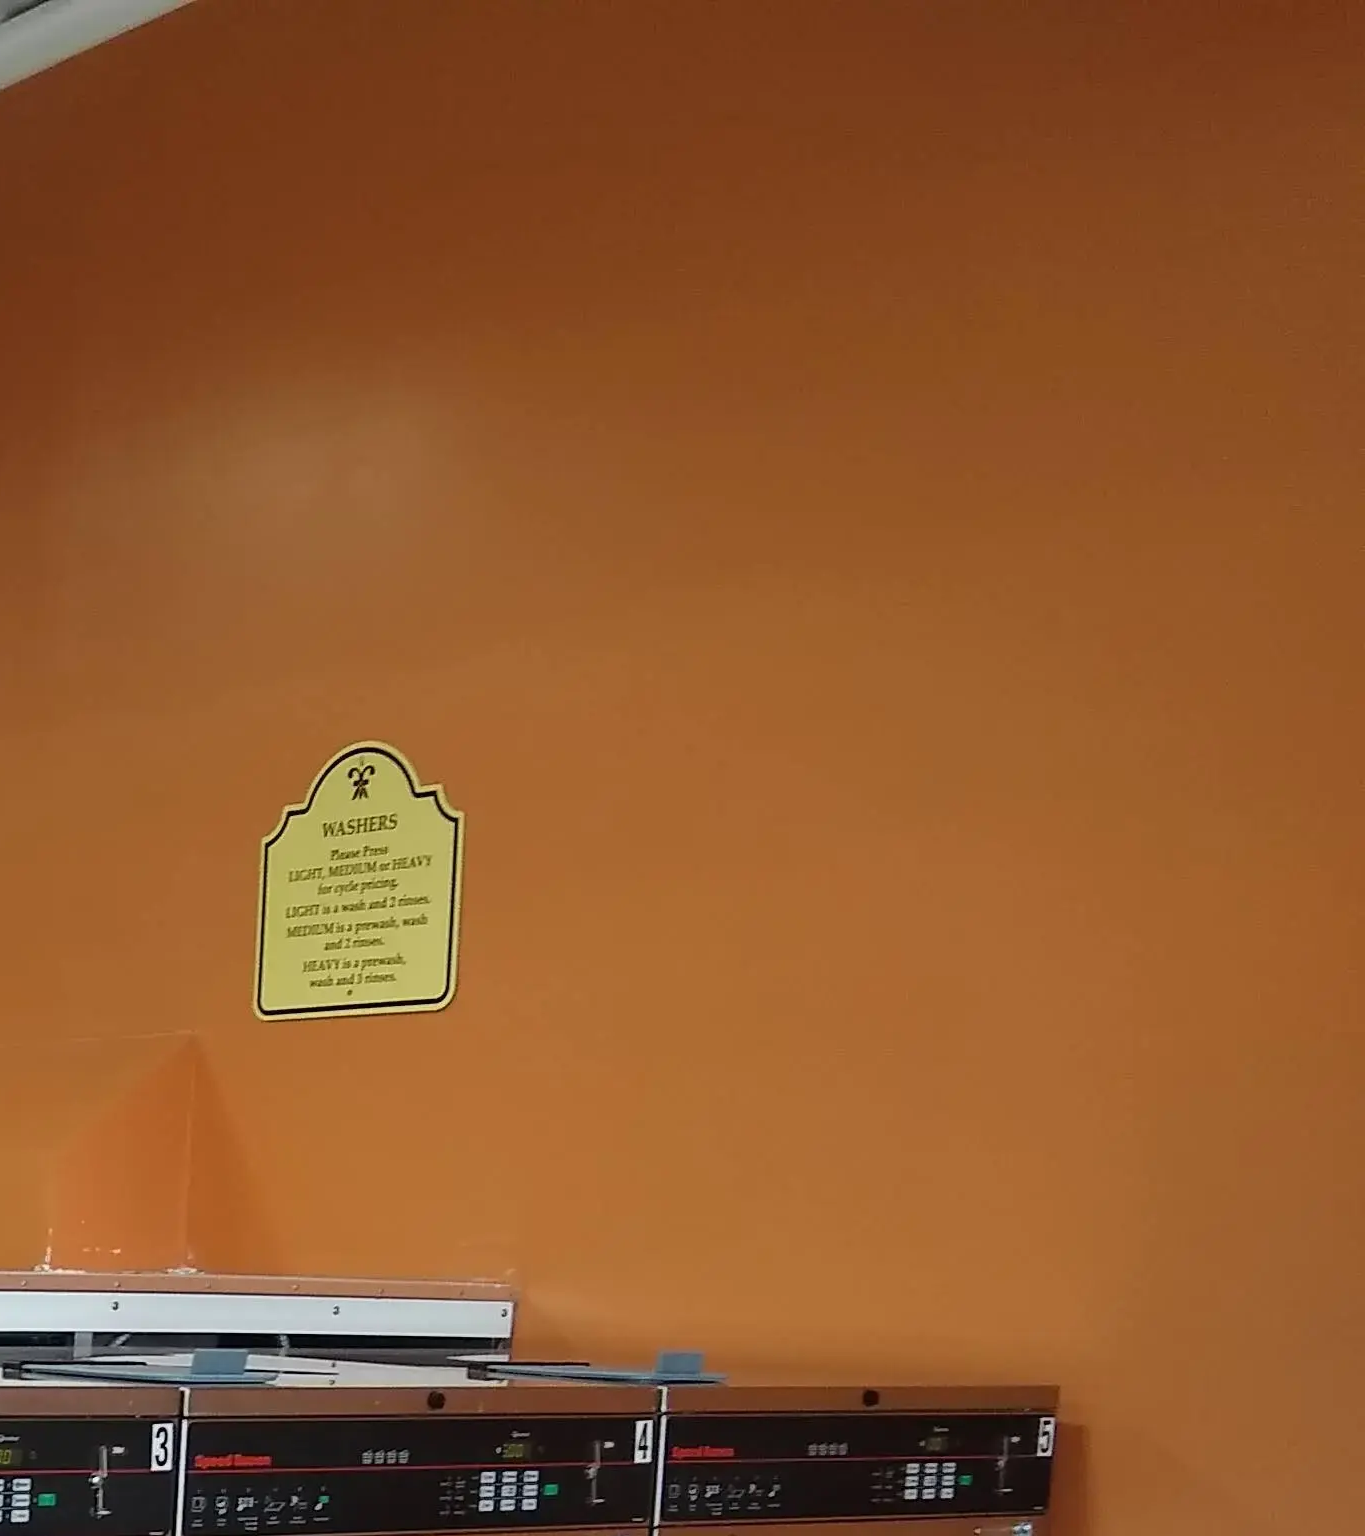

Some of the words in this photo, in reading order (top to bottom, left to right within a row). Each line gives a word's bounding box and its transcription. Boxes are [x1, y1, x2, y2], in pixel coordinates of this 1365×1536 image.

[322, 813, 398, 838] WASHERS
[330, 849, 360, 861] Please
[362, 845, 389, 857] Press
[288, 867, 325, 883] LIGHT,
[329, 861, 377, 877] MEDIUM
[379, 861, 390, 870] or
[392, 855, 433, 871] HEAVY
[317, 883, 332, 895] for
[333, 880, 358, 896] cycle
[285, 904, 320, 918] LIGHT
[322, 905, 331, 915] is
[341, 900, 366, 912] wash
[368, 897, 387, 910] and
[286, 922, 333, 938] MEDIUM
[335, 922, 345, 933] is
[402, 913, 428, 927] wash
[324, 938, 342, 951] and
[302, 958, 340, 973] HEAVY
[341, 958, 351, 969] is
[310, 974, 333, 987] wash
[335, 973, 355, 986] and
[155, 1427, 169, 1467] 3
[638, 1422, 649, 1460] 4
